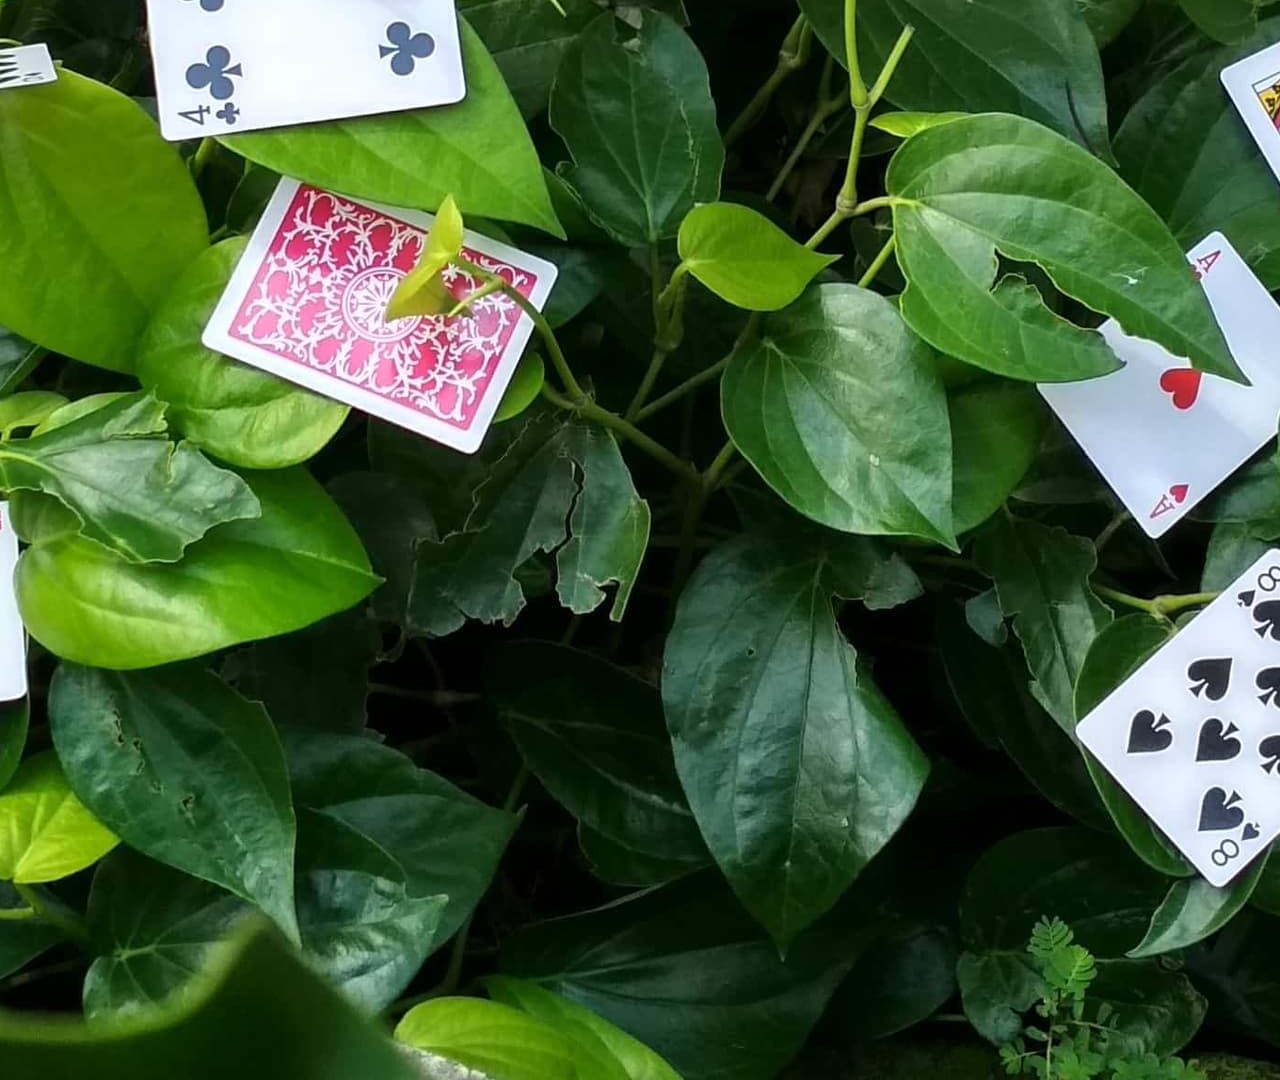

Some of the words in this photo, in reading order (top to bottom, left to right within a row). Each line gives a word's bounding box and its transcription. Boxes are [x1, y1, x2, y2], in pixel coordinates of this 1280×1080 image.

[177, 104, 211, 125] 4
[1197, 250, 1221, 273] A
[1149, 494, 1175, 519] A
[1211, 839, 1239, 866] 8
